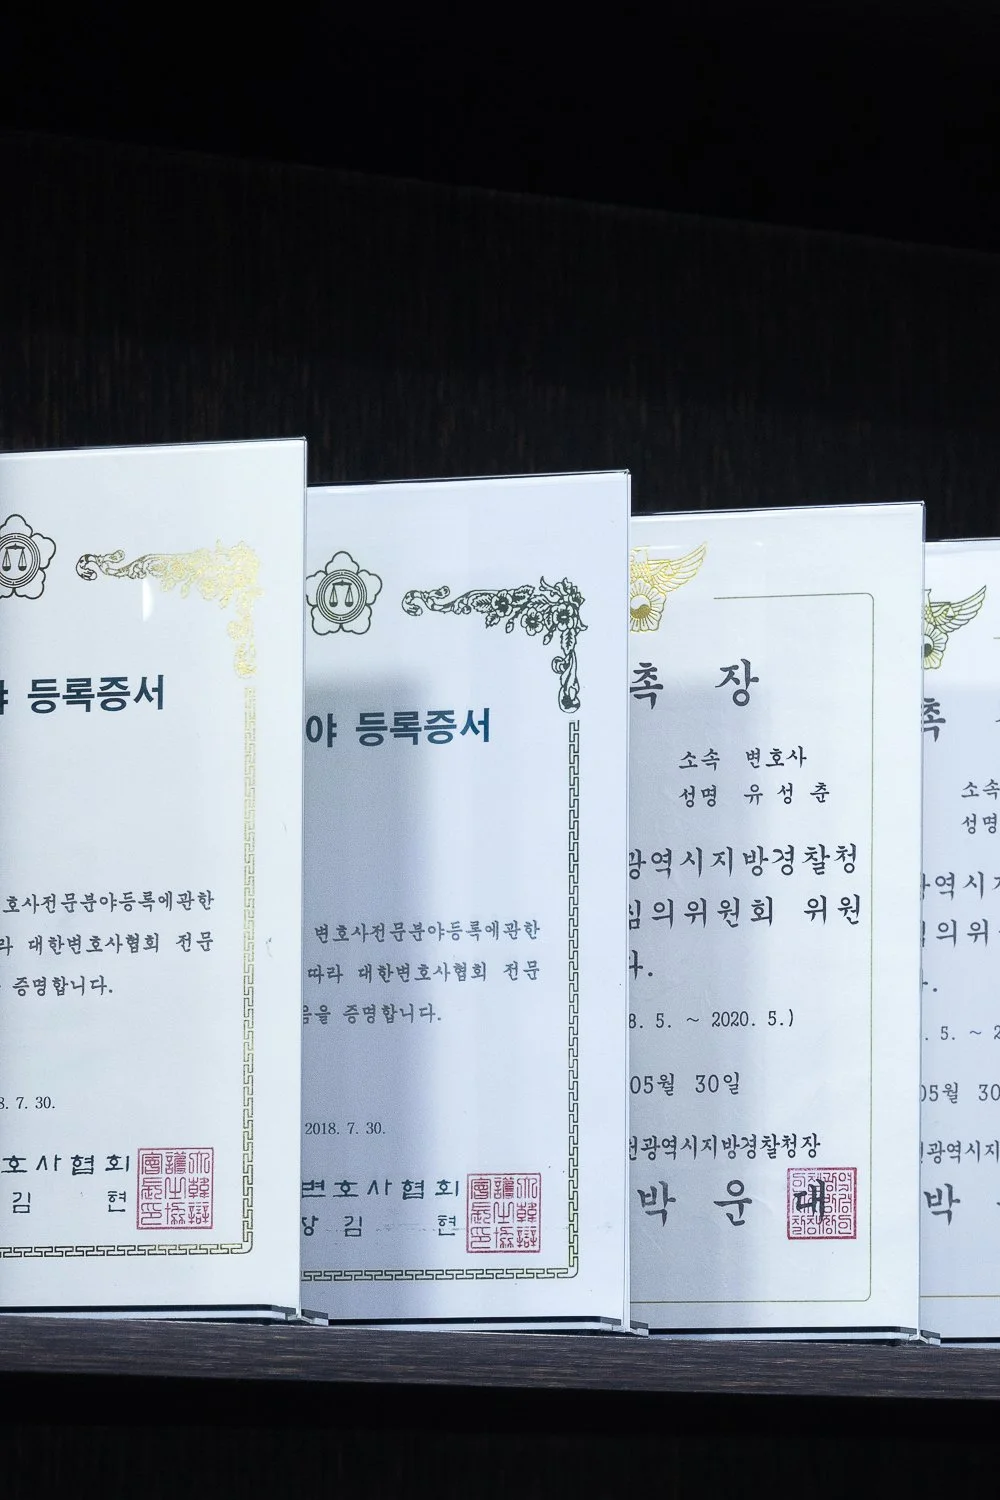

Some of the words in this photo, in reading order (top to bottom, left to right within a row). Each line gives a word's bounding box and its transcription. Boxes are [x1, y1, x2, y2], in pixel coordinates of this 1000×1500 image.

[28, 675, 163, 713] 등록증서
[715, 659, 759, 706] 장
[306, 713, 337, 747] 야
[356, 708, 489, 747] 등록증서
[679, 748, 720, 771] 소속
[746, 746, 807, 768] 변호사
[680, 785, 716, 808] 성명
[961, 779, 1000, 800] 소속
[963, 813, 997, 834] 성명
[3, 890, 214, 914] 호사전문분야등록에관한
[804, 894, 859, 925] 위원
[28, 933, 158, 955] 대한변호사협회
[176, 932, 213, 952] 전문
[312, 919, 540, 945] 변호사전문분야등록에관한
[308, 964, 343, 984] 따라
[358, 962, 486, 983] 대한변호사협회
[504, 960, 539, 981] 전문
[12, 975, 112, 996] 증명합니다.
[343, 1003, 440, 1024] 증명합니다.
[656, 1013, 671, 1028] 5.
[712, 1011, 755, 1027] 2020.
[768, 1009, 793, 1026] 5.)
[941, 1026, 955, 1040] 5.
[630, 1073, 674, 1096] 05월
[696, 1072, 739, 1095] 30일
[16, 1097, 27, 1109] 7.
[36, 1096, 55, 1109] 30.
[305, 1123, 339, 1134] 2018.
[347, 1122, 358, 1134] 7.
[366, 1122, 385, 1134] 30.
[1, 1154, 129, 1175] 호사협회
[301, 1176, 458, 1200] 변호사협회
[13, 1192, 30, 1213] 김
[108, 1191, 126, 1212] 현
[637, 1181, 676, 1226] 박
[714, 1180, 752, 1226] 운
[924, 1184, 960, 1225] 박
[344, 1216, 362, 1237] 김
[438, 1215, 456, 1236] 현
